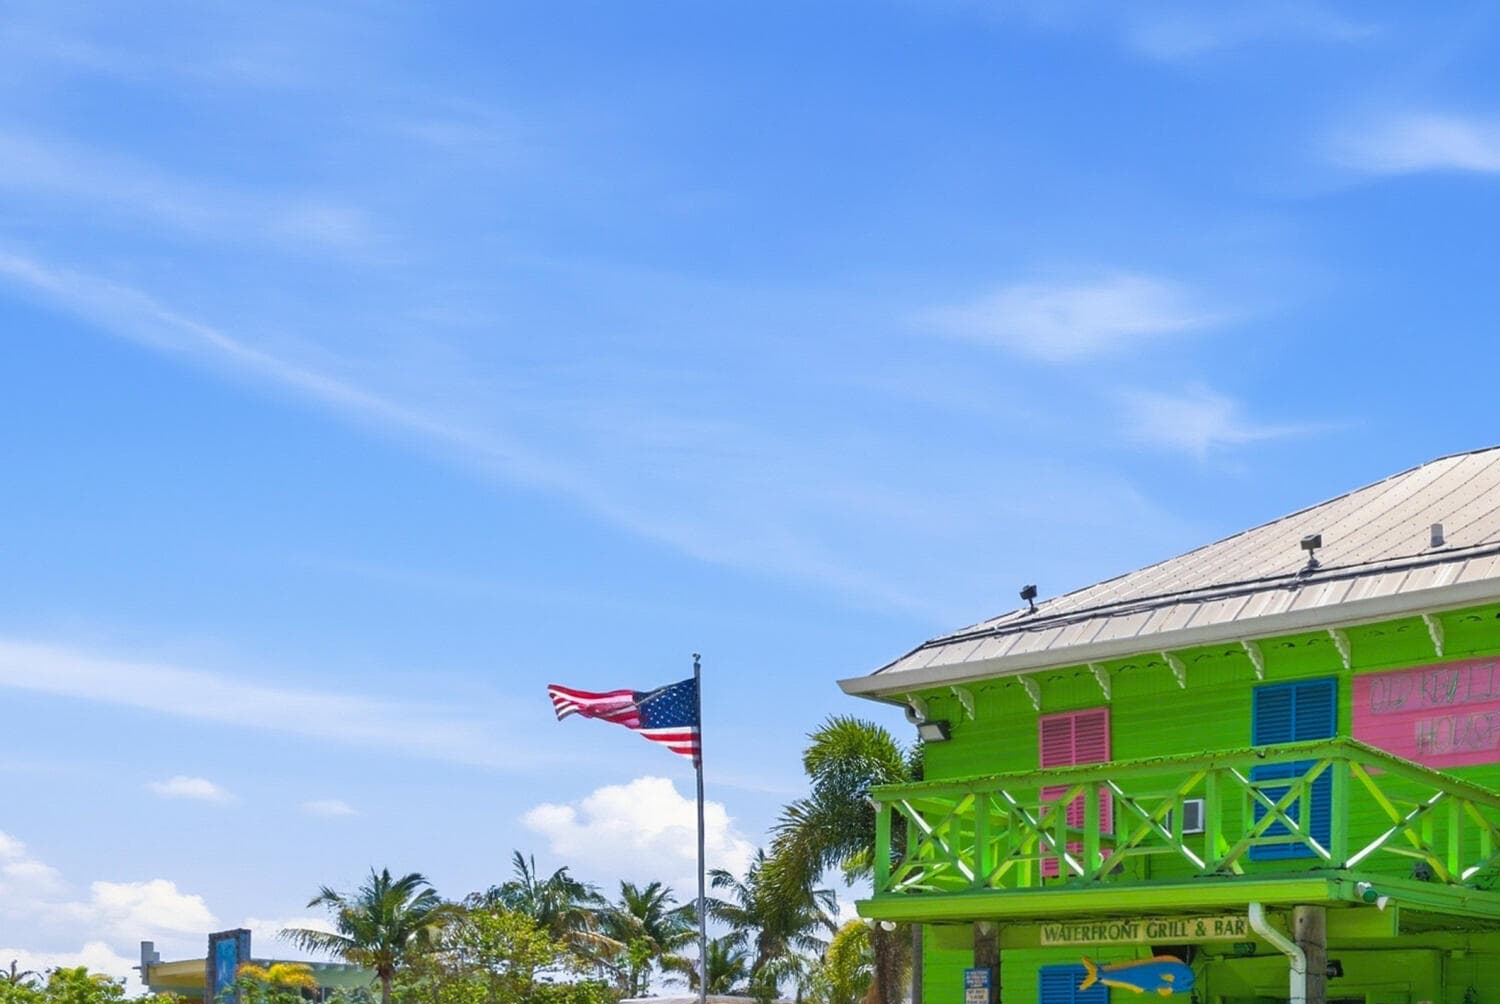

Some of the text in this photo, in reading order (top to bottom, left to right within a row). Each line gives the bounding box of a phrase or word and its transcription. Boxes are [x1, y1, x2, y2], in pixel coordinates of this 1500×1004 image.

[1043, 917, 1246, 942] WATERFRONT GRILL & BAR
